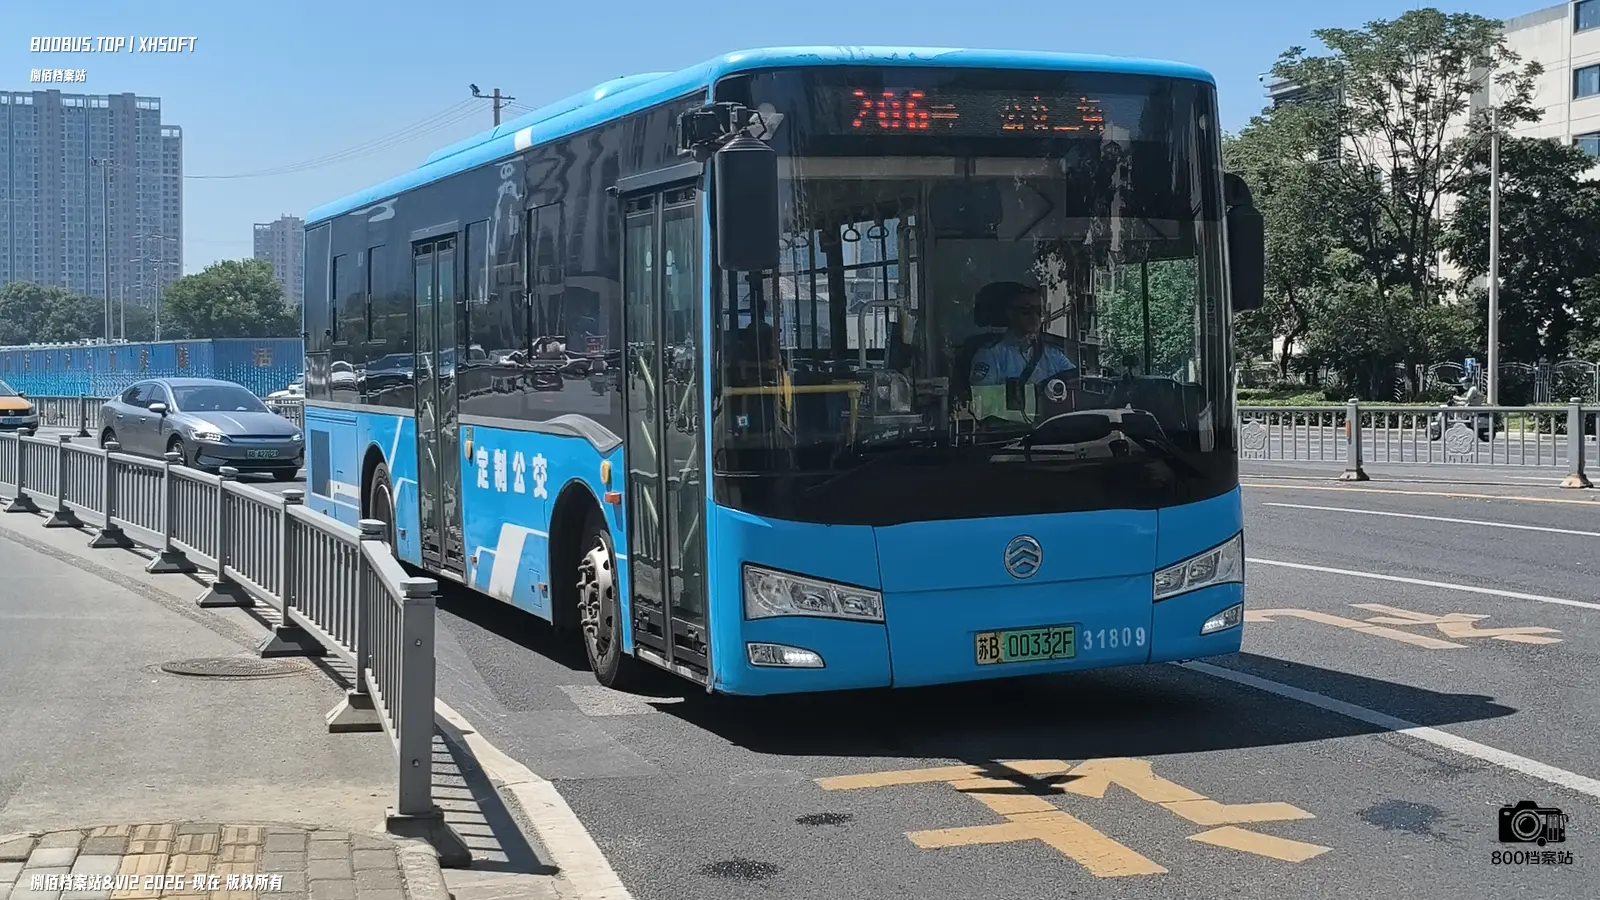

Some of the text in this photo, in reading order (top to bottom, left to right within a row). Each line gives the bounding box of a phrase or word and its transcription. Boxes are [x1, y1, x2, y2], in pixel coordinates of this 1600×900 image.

[476, 445, 548, 500] 定制公交
[1083, 626, 1146, 650] 31809
